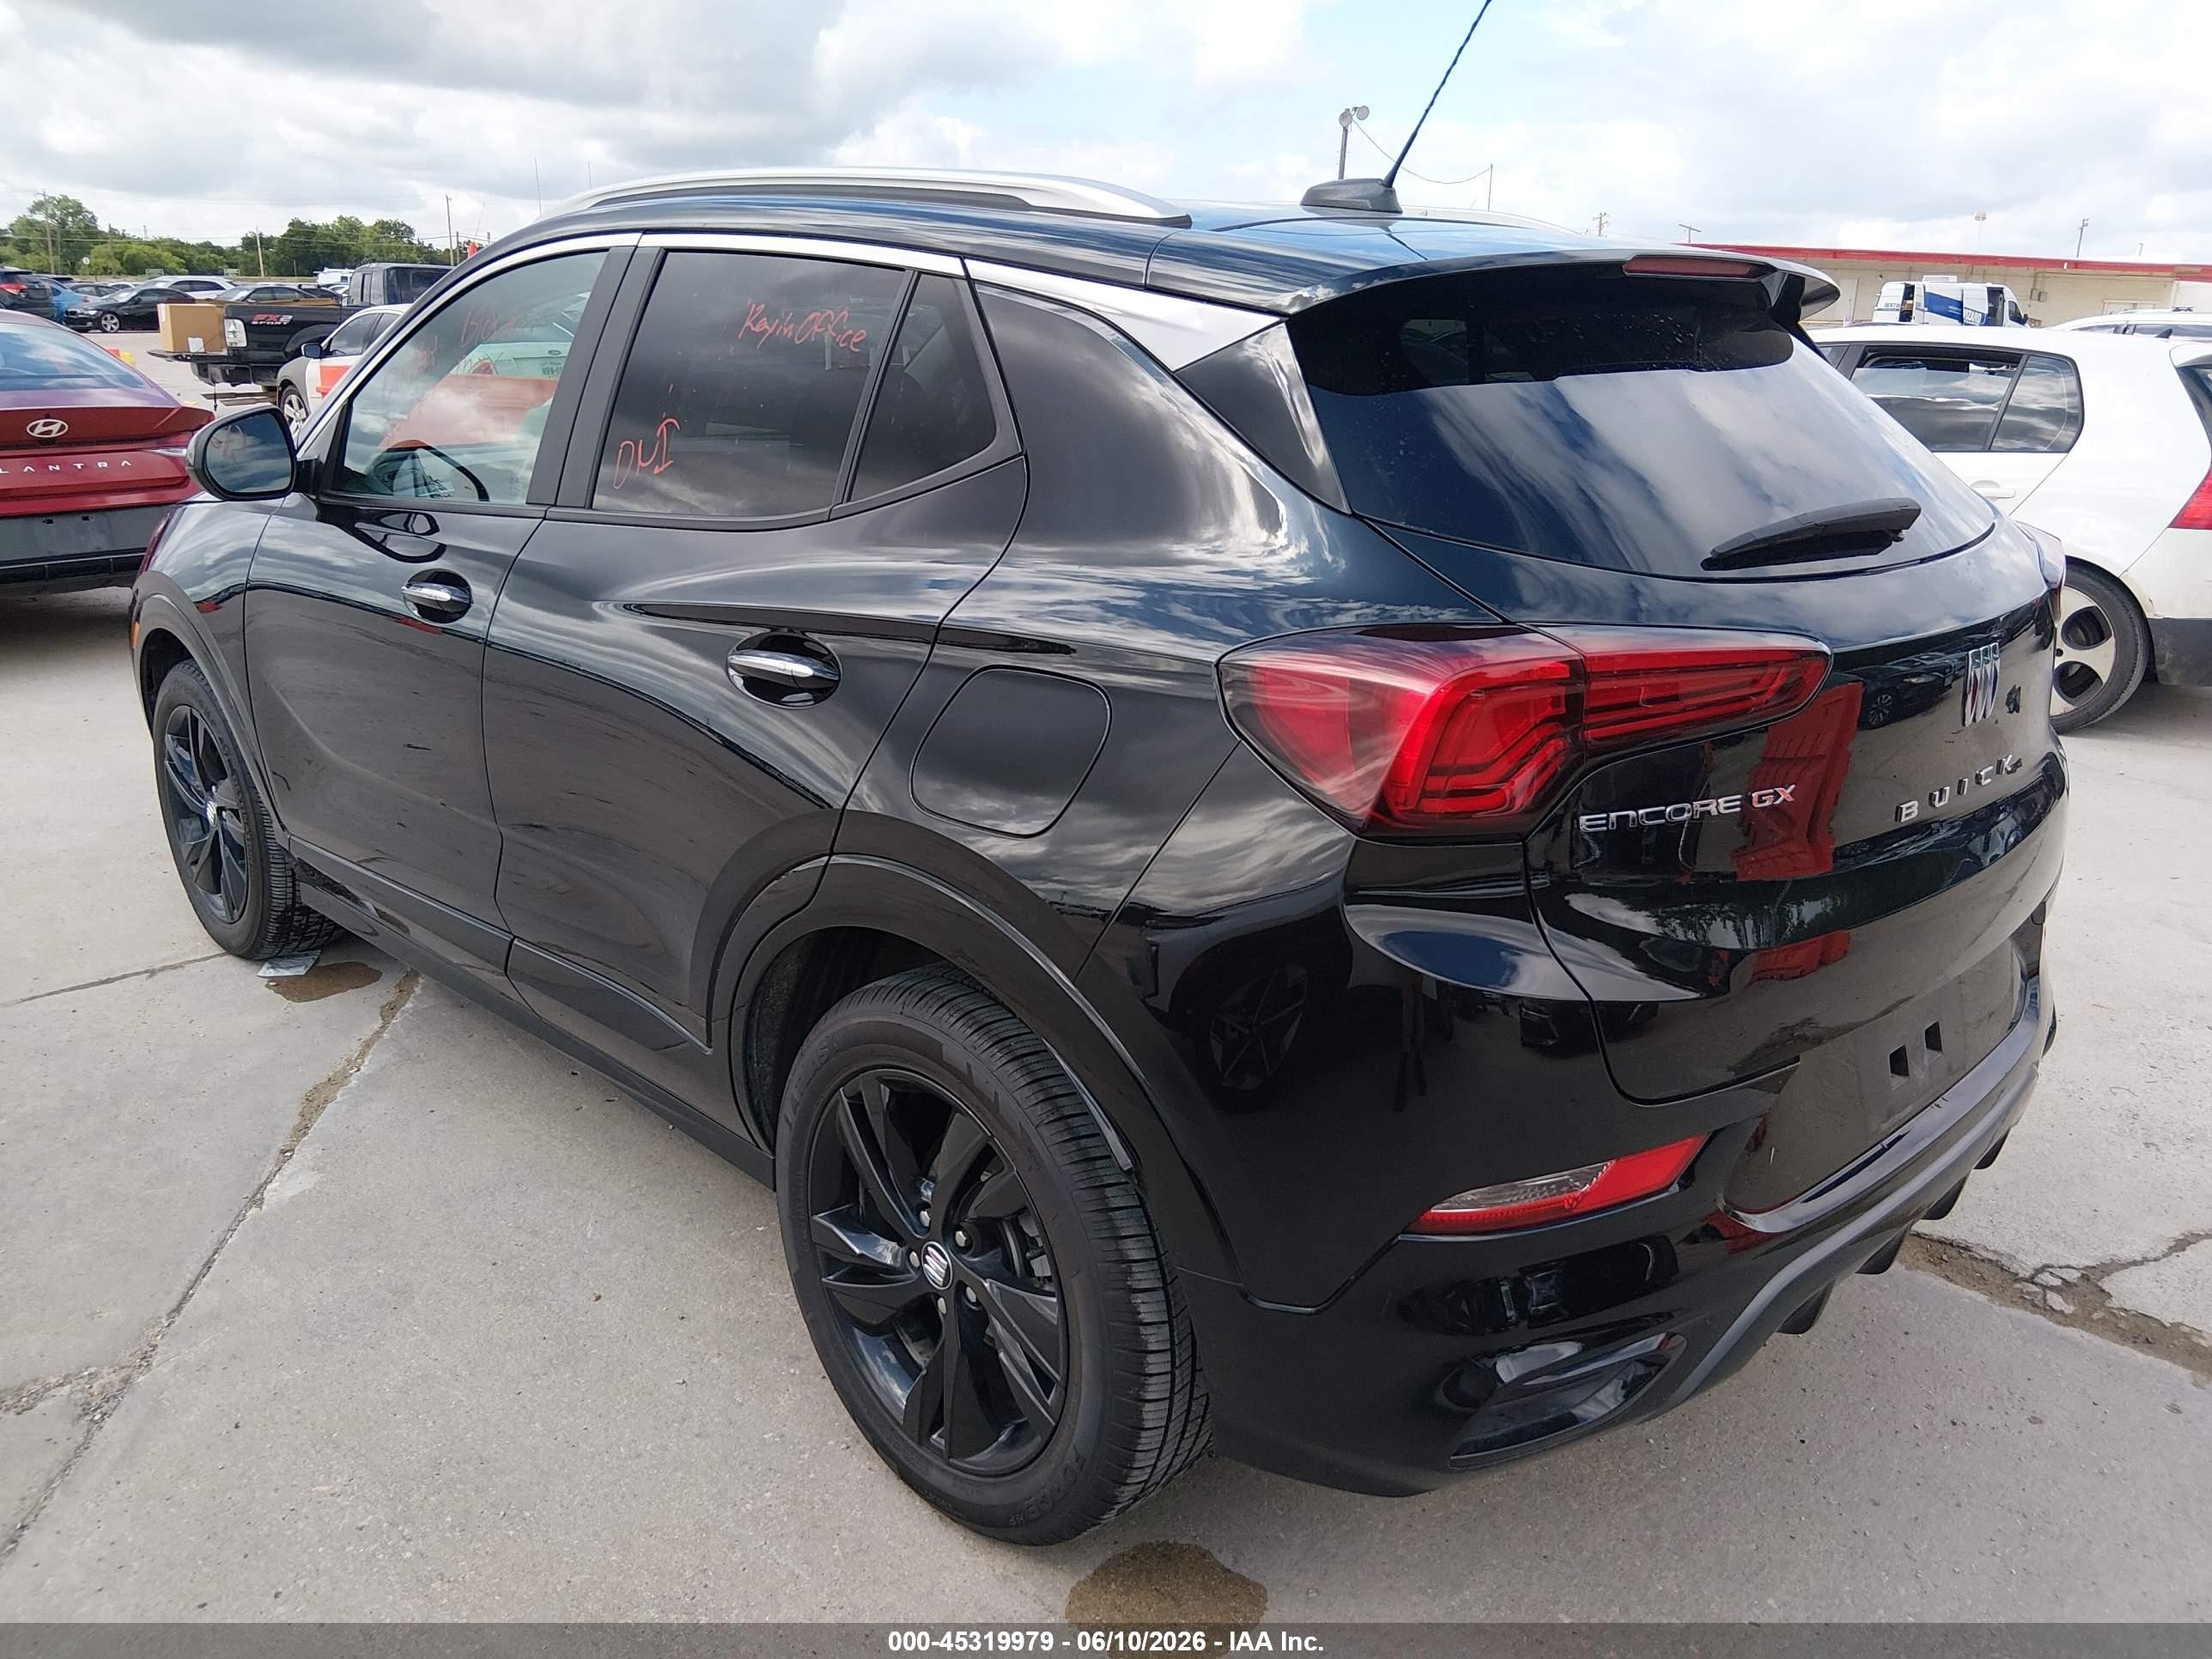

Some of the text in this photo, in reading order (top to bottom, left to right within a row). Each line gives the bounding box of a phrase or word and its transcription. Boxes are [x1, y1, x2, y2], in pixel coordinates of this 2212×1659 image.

[1579, 784, 1796, 833] ENCORE GX
[1894, 754, 2012, 823] BUICK
